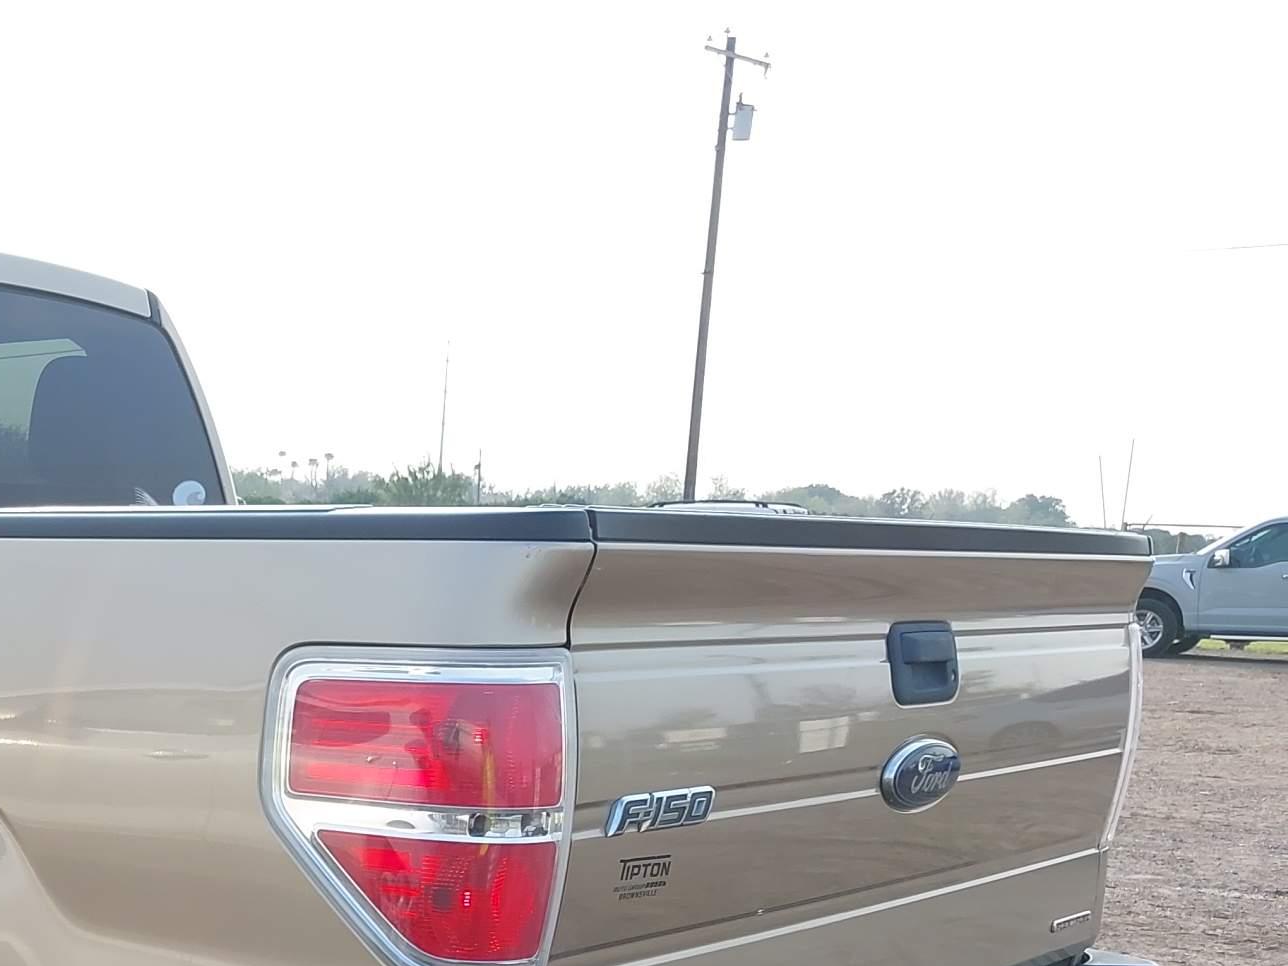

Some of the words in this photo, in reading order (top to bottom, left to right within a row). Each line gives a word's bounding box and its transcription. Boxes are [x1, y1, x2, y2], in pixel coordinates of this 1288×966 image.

[911, 754, 953, 794] Ford
[607, 785, 716, 837] F-150
[620, 854, 672, 880] TIPTON
